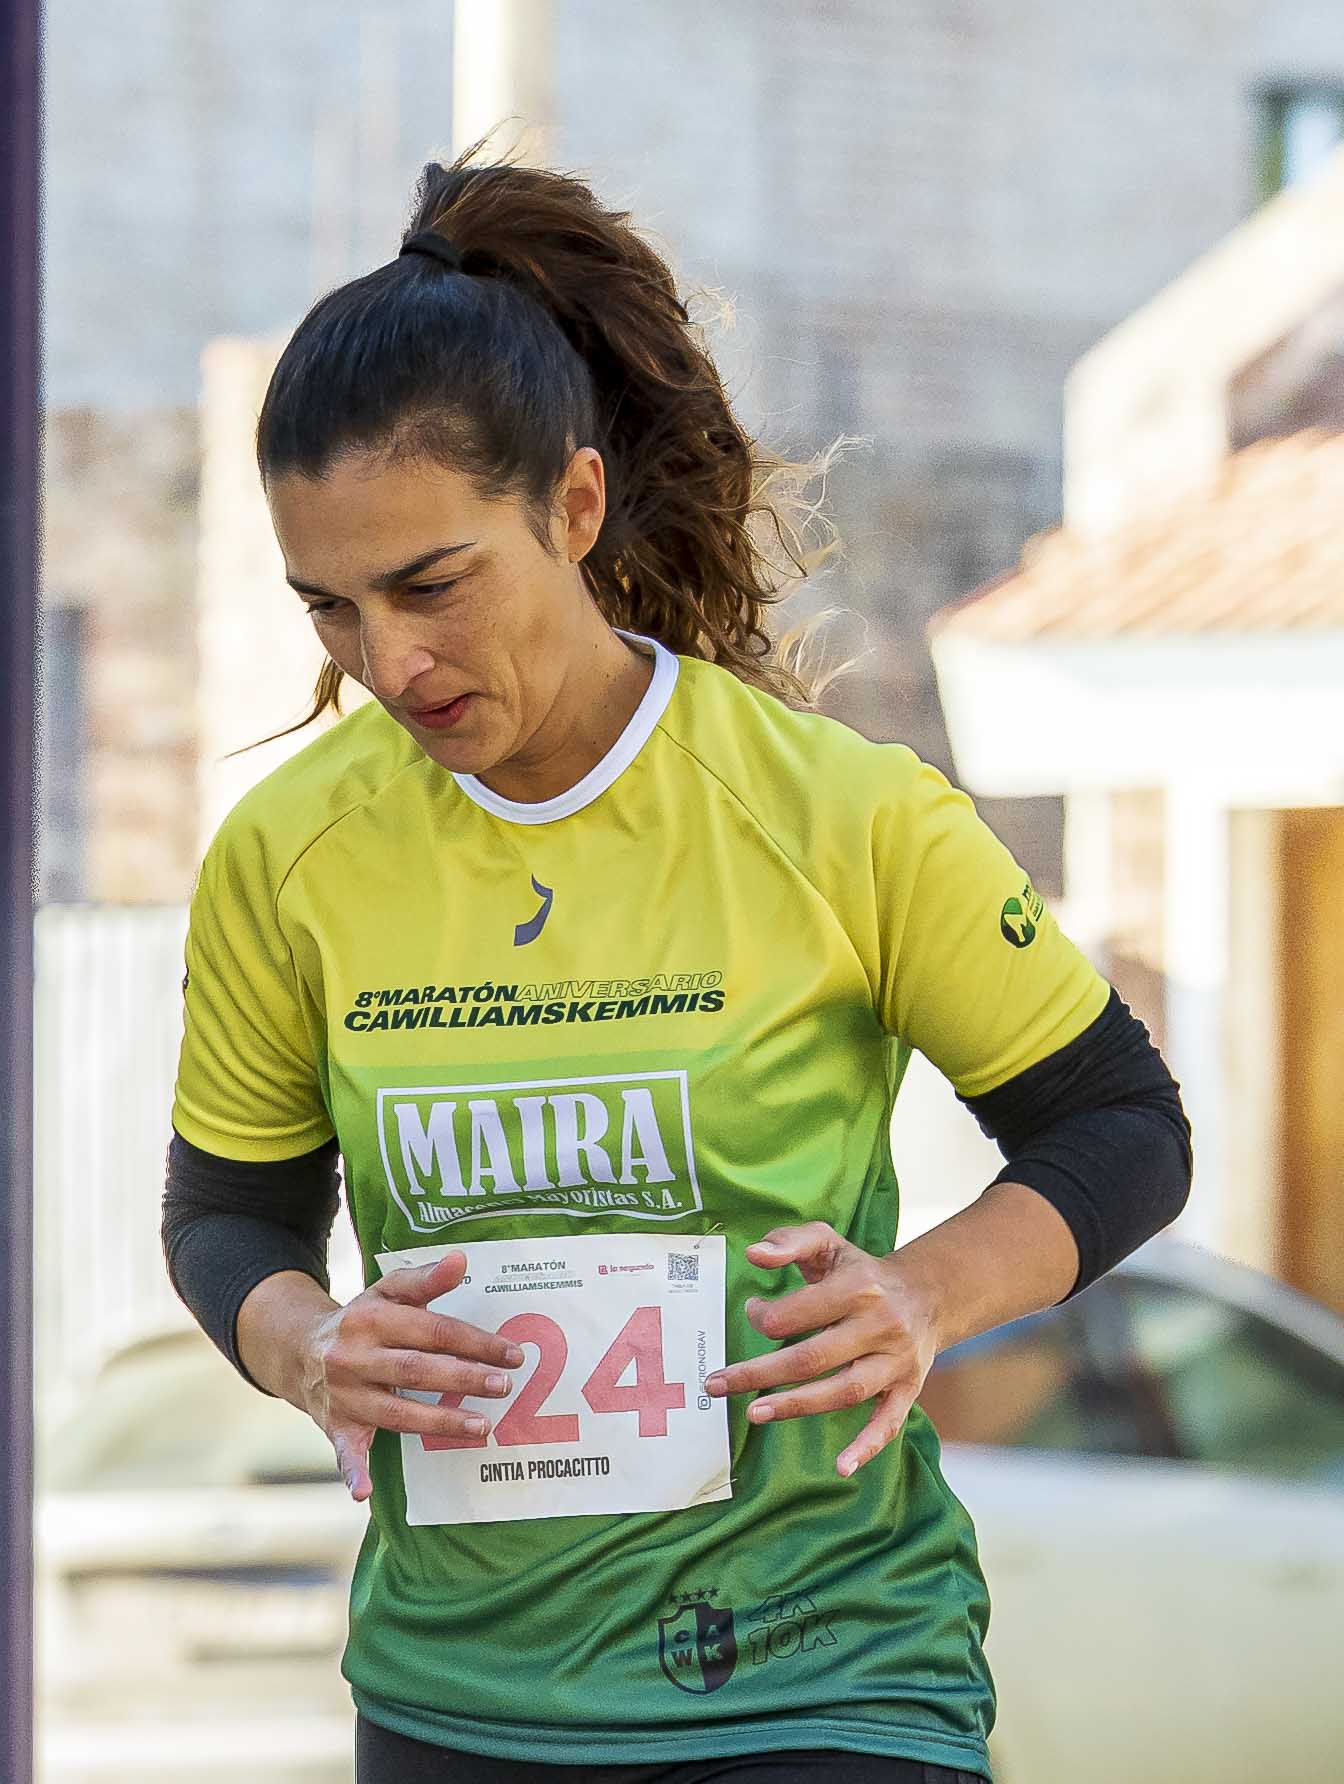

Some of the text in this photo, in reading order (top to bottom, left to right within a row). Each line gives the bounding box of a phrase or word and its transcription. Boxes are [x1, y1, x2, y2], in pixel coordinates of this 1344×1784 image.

[343, 989, 726, 1033] CAWILLIAMSKEMMIS
[393, 1087, 677, 1197] MAIRA
[644, 1188, 683, 1210] S.A.
[479, 1456, 611, 1483] CINTIA PROCACITTO
[748, 1608, 841, 1666] 10K
